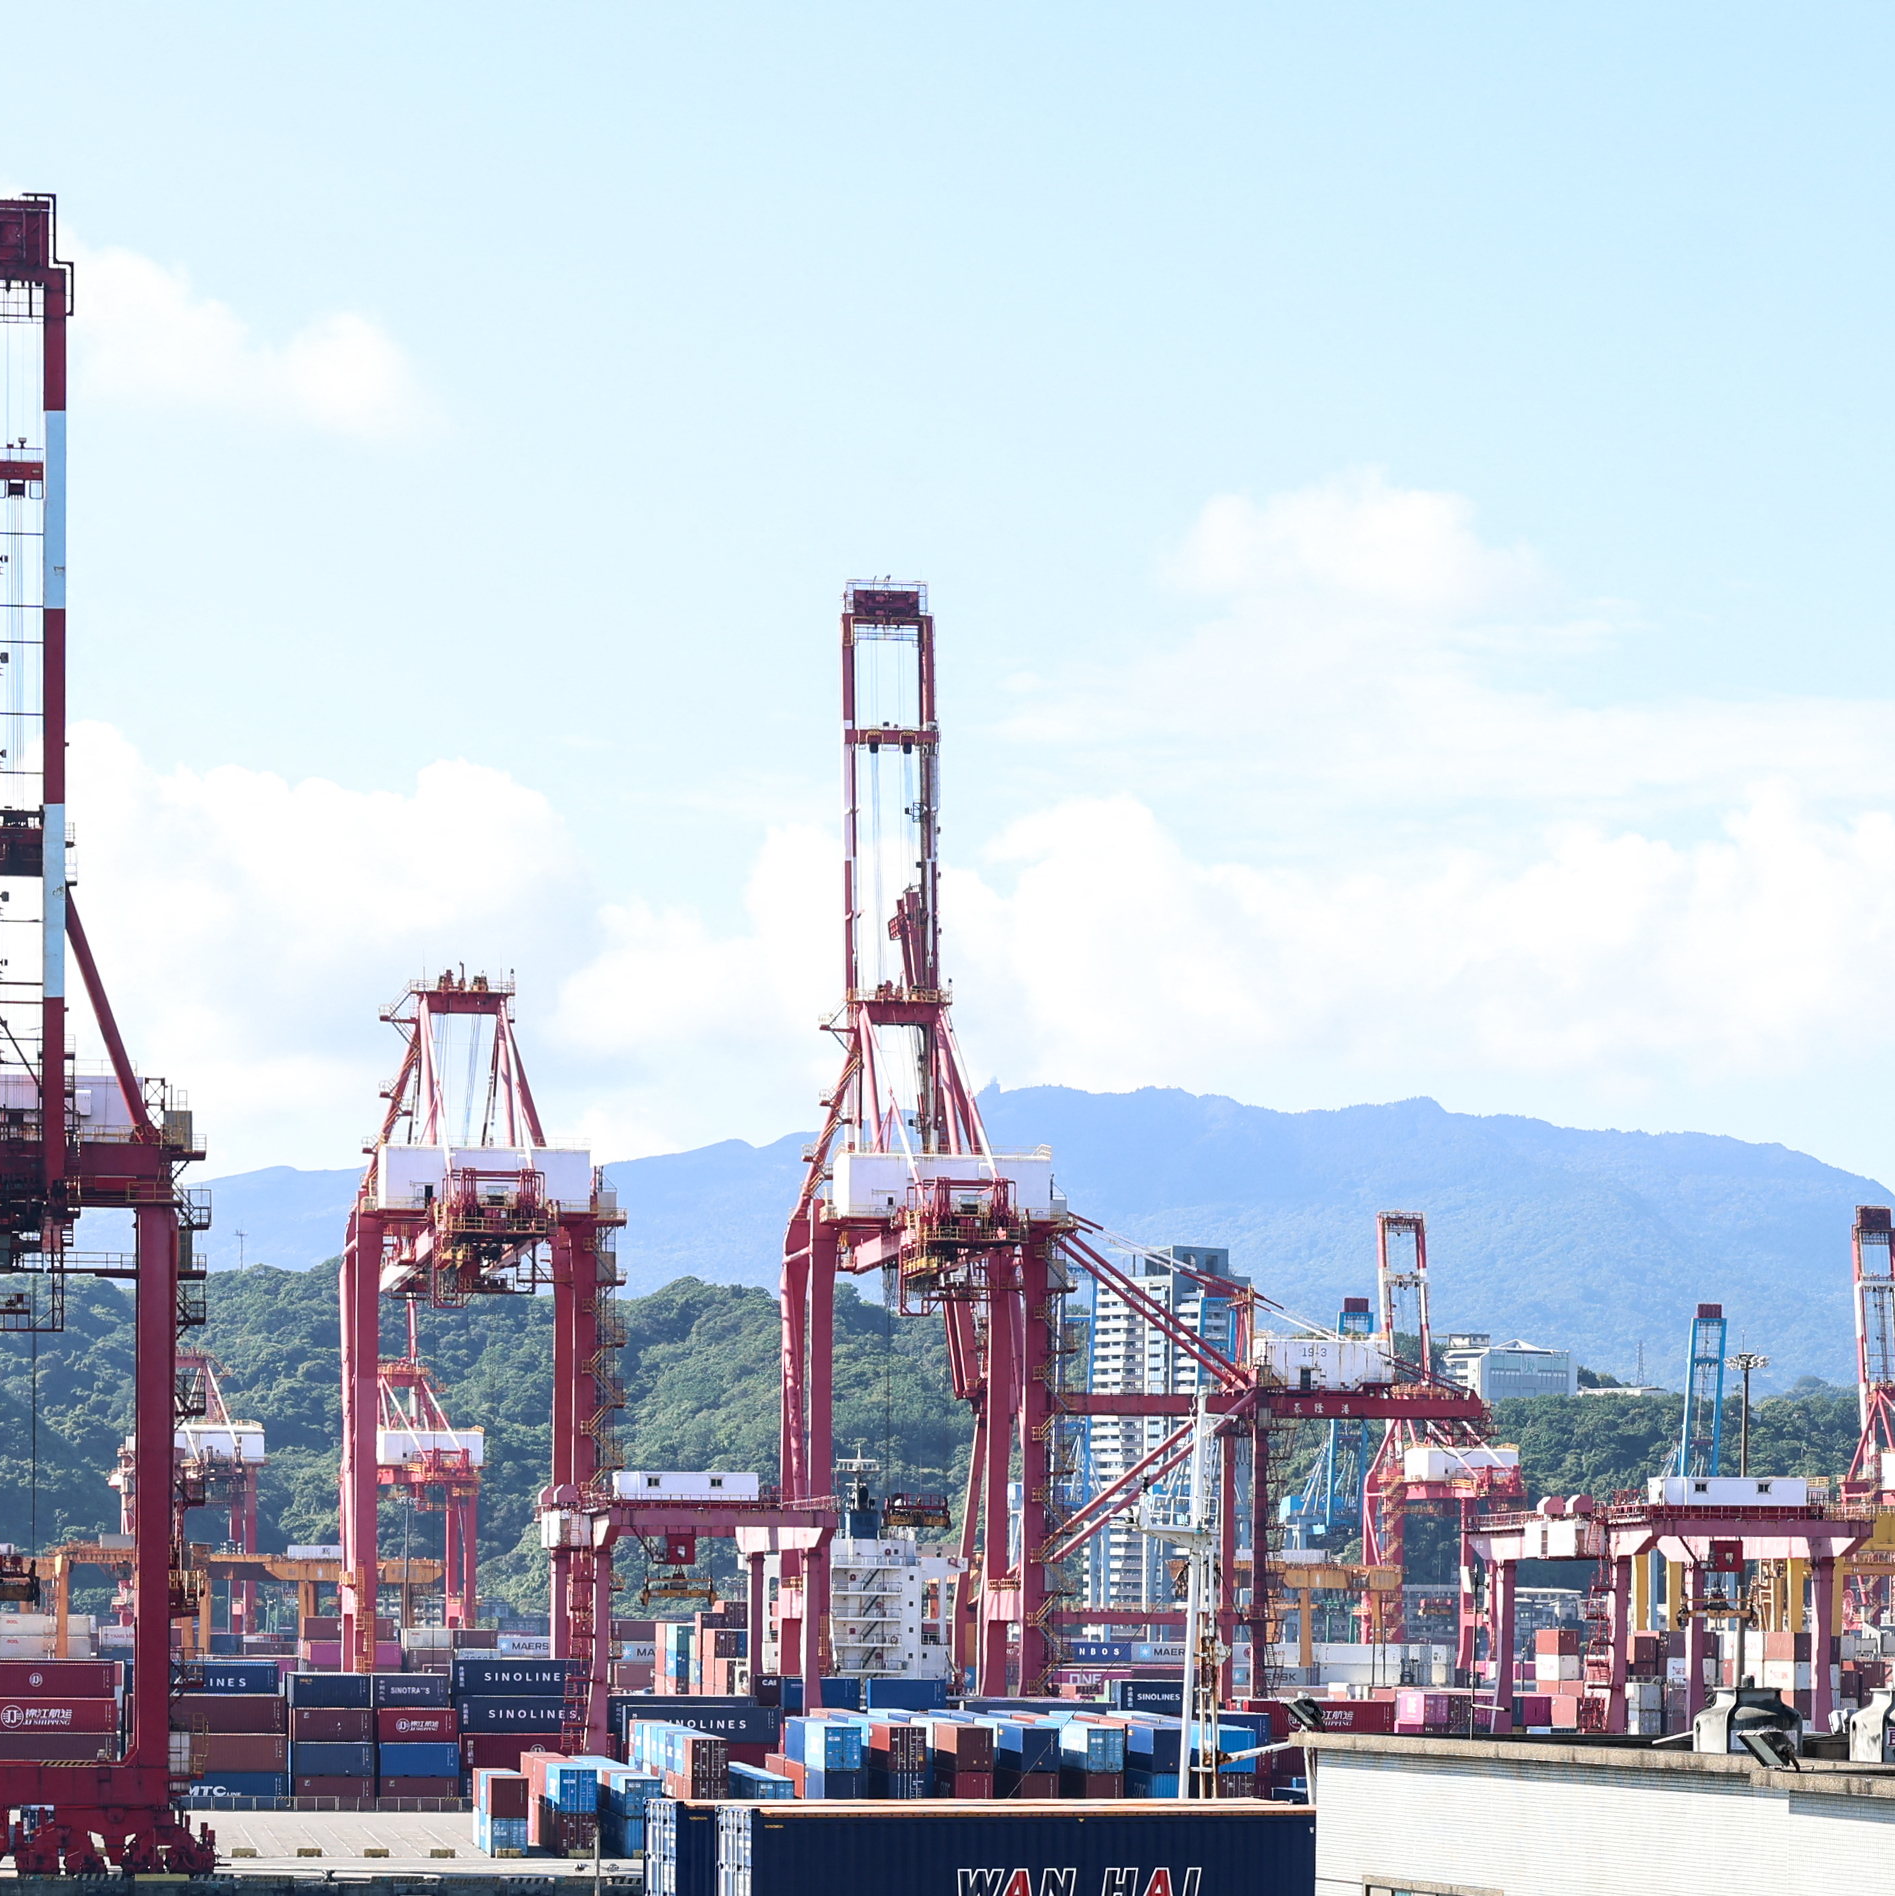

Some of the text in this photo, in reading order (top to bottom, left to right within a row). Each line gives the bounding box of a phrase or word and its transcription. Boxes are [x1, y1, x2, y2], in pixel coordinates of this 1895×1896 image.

[511, 1641, 549, 1651] MAERS
[1079, 1647, 1120, 1656] NBOS
[484, 1672, 572, 1682] SINOLINES
[1069, 1673, 1102, 1684] ONE
[762, 1679, 777, 1687] CAI
[1137, 1692, 1181, 1701] SINOLINES
[488, 1709, 578, 1719] SINOLINES
[33, 1718, 70, 1726] SHIPPING
